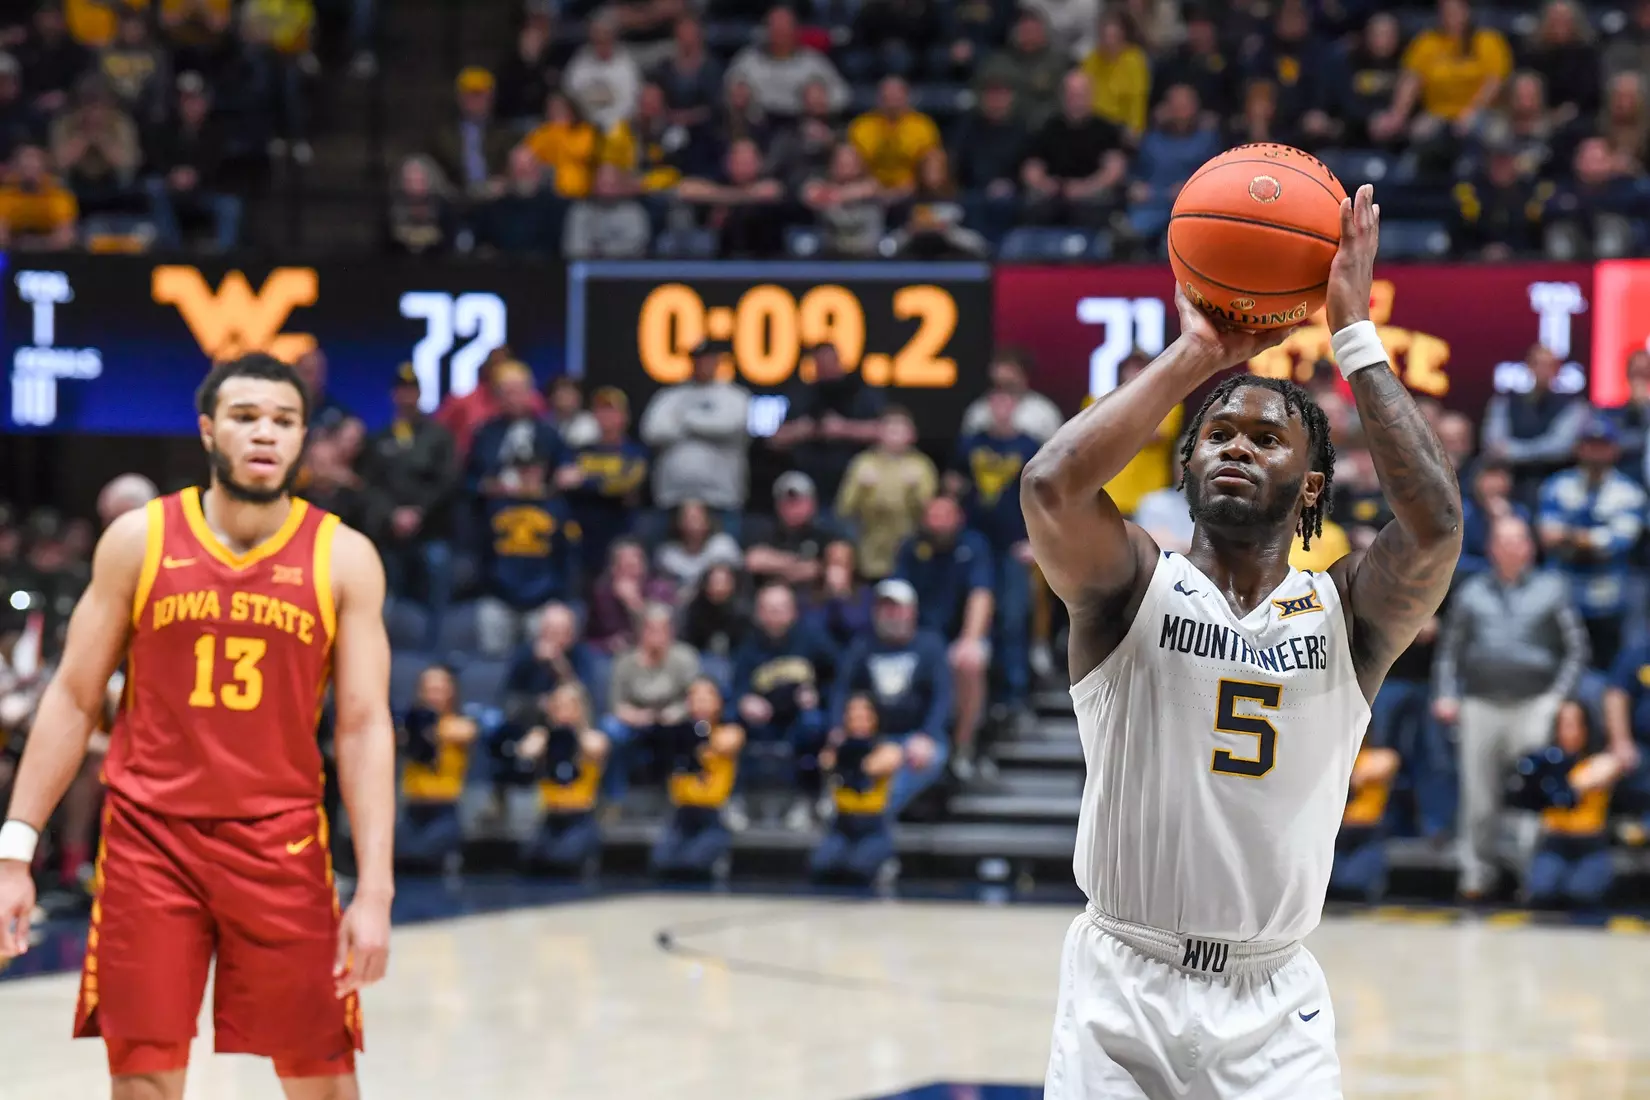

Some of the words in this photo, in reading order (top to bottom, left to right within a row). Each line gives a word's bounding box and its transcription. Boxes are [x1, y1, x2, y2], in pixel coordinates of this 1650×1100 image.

[400, 291, 508, 414] 72
[637, 283, 959, 388] 0:09.2
[1077, 297, 1166, 399] 71
[152, 590, 221, 631] IOWA
[230, 591, 316, 645] STATE
[188, 634, 267, 711] 13
[1210, 677, 1283, 779] 5
[1182, 938, 1229, 973] WVU
